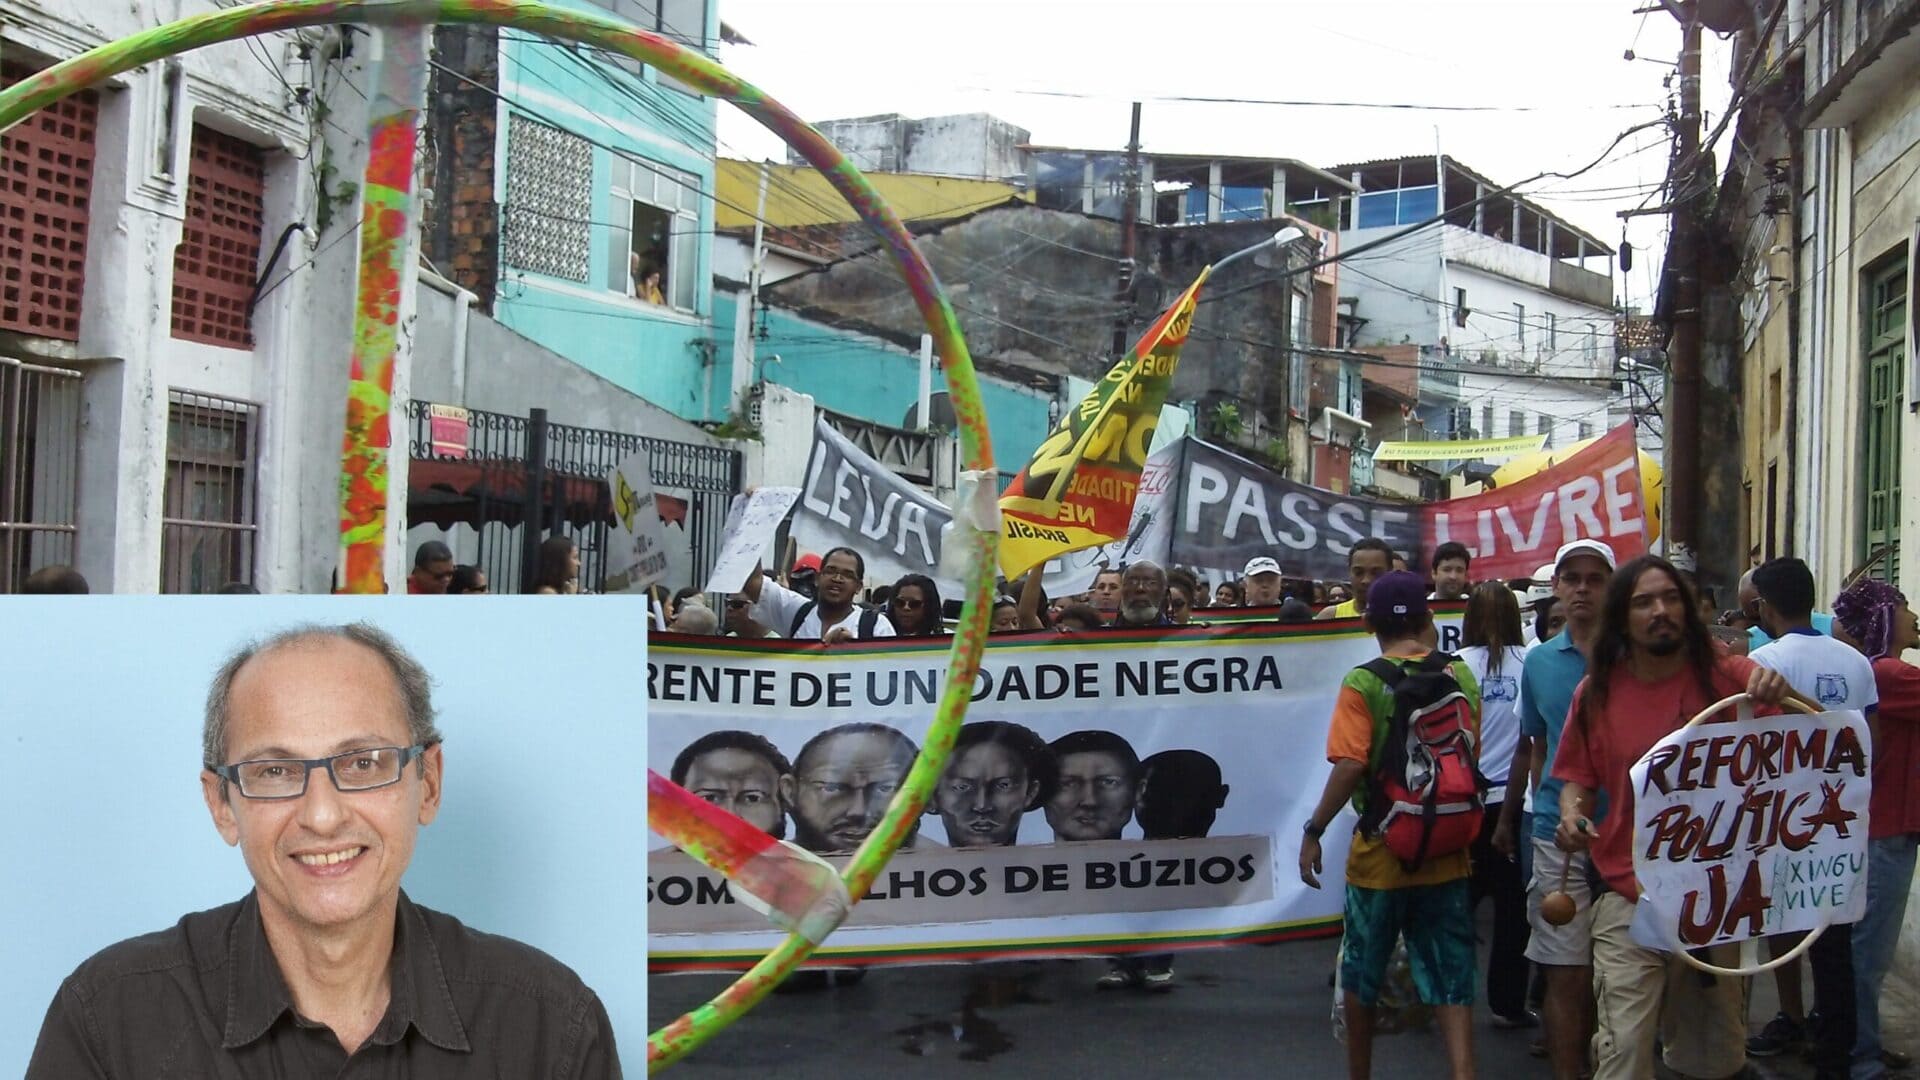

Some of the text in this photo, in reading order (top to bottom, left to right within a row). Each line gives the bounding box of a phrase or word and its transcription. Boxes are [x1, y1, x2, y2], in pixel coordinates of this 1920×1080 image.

[1186, 457, 1643, 558] PASSE LIVRE
[789, 671, 852, 708] DE
[866, 662, 1100, 705] UNDADE
[1115, 655, 1283, 697] NEGRA
[1641, 726, 1868, 798] REFORMA
[1004, 864, 1069, 894] DE
[1085, 852, 1256, 890] BÚZIOS
[1784, 884, 1845, 910] VIVE
